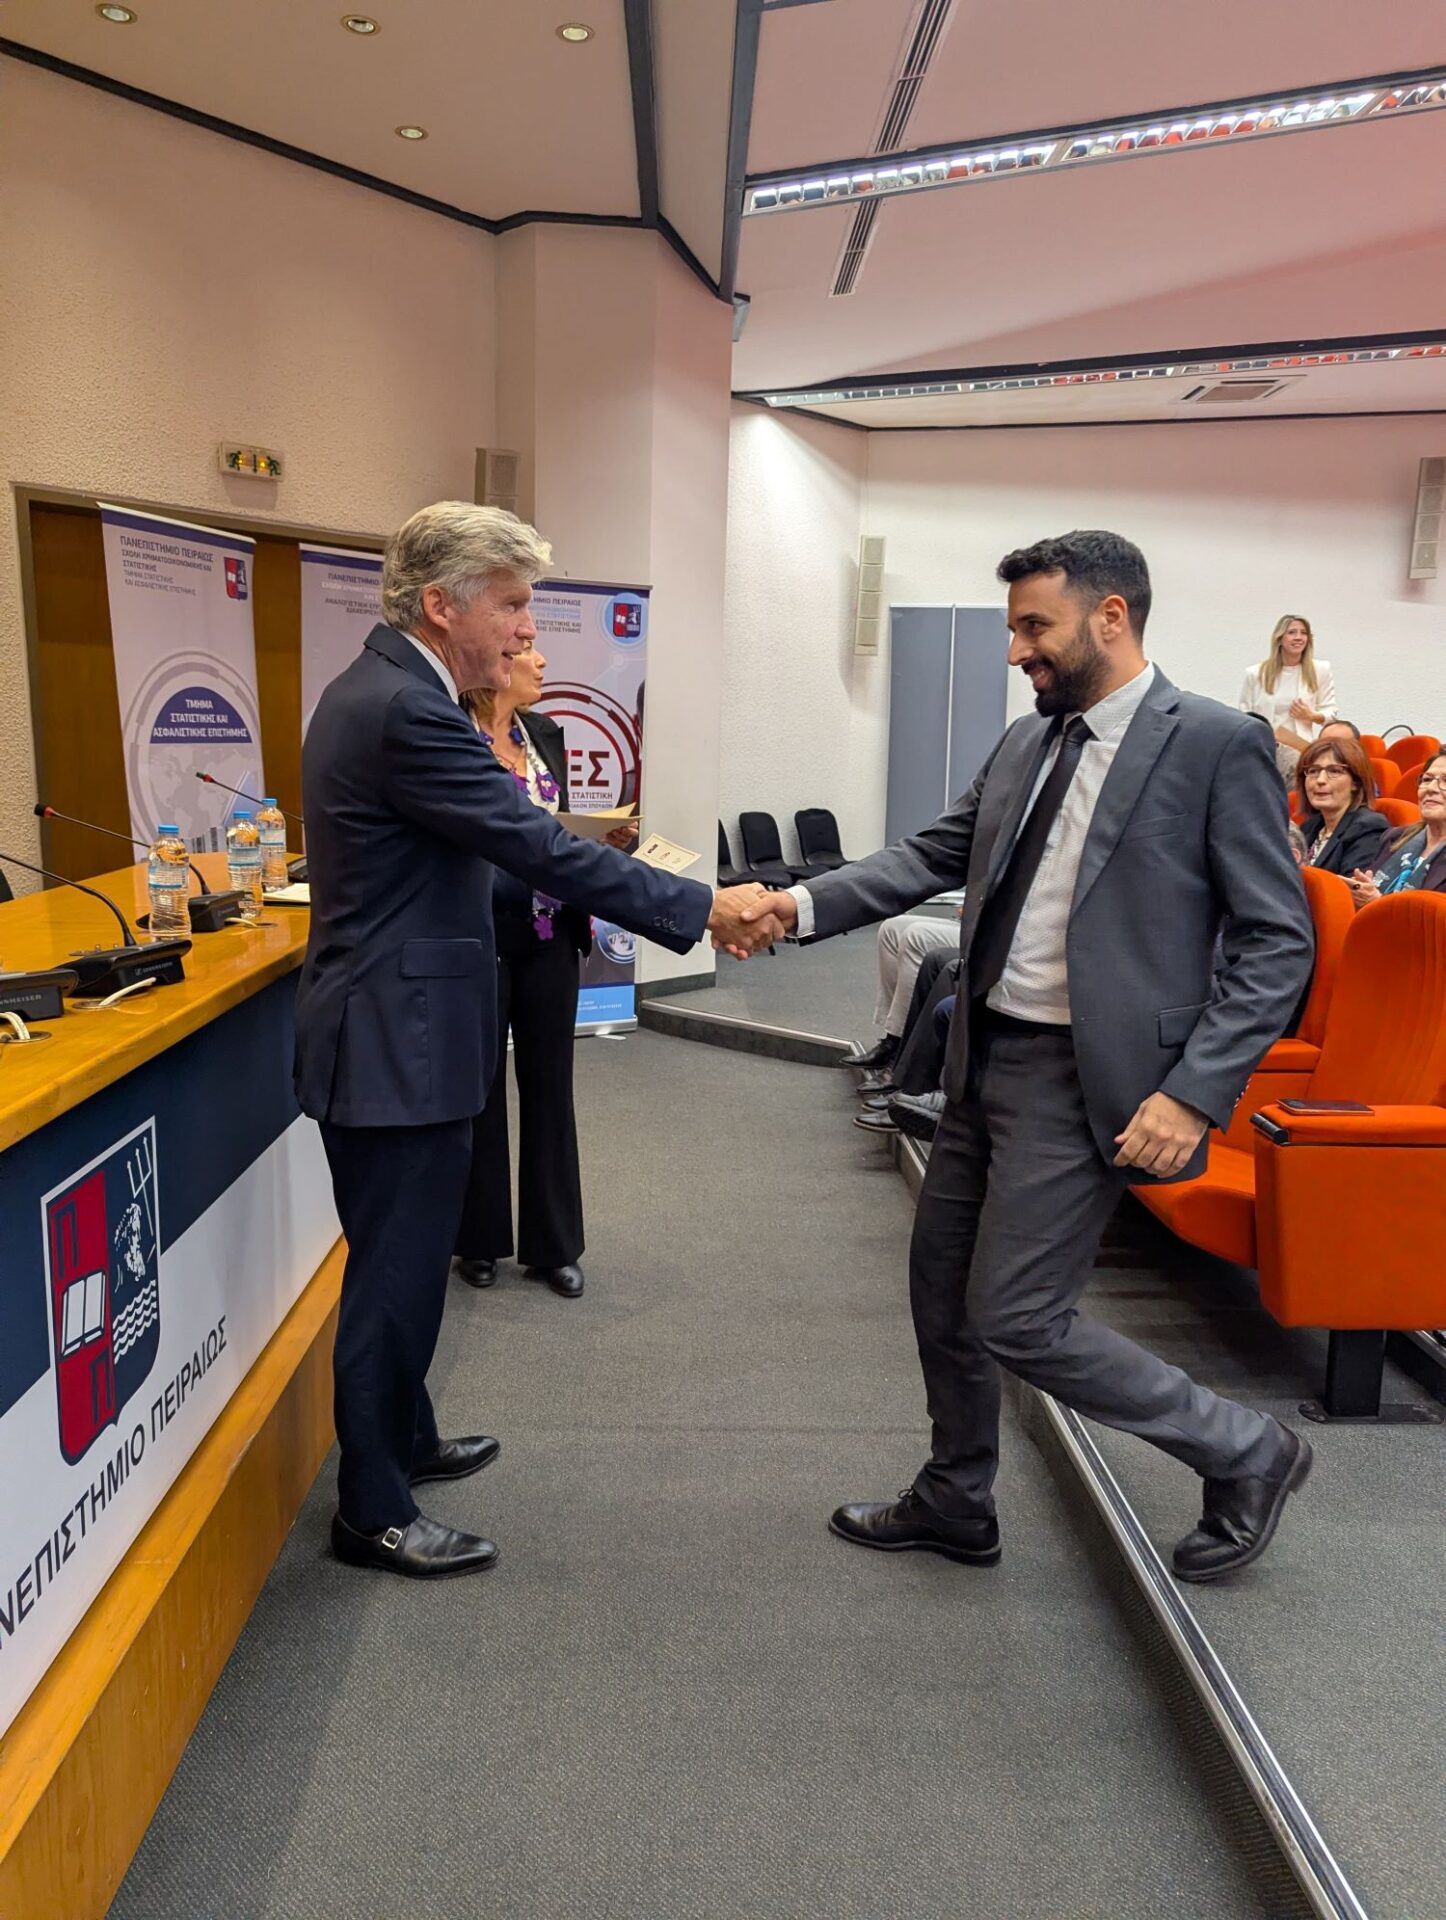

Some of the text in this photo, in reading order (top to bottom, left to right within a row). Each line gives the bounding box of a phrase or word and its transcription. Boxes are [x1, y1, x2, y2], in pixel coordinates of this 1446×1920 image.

[120, 535, 214, 562] ΠΑΝΕΠΙΣΤΗΜΙΟ ΠΕΙΡΑΙΩΣ
[123, 560, 157, 572] ΣΤΑΤΙΣΤΙΚΗΣ
[328, 572, 380, 585] ΠΑΝΕΠΙΣΤΗΜΙΟ
[185, 699, 214, 709] ΤΜΗΜΑ
[170, 713, 228, 723] ΣΤΑΤΙΣΤΙΚΗΣ ΚΑΙ
[153, 727, 248, 737] ΑΣΦΑΛΙΣΤΙΚΗΣ ΕΠΙΣΤΗΜΗΣ
[0, 1315, 228, 1650] ΝΕΠΙΣΤΗΜΙΟ ΠΕΙΡΑΙΩΣ
